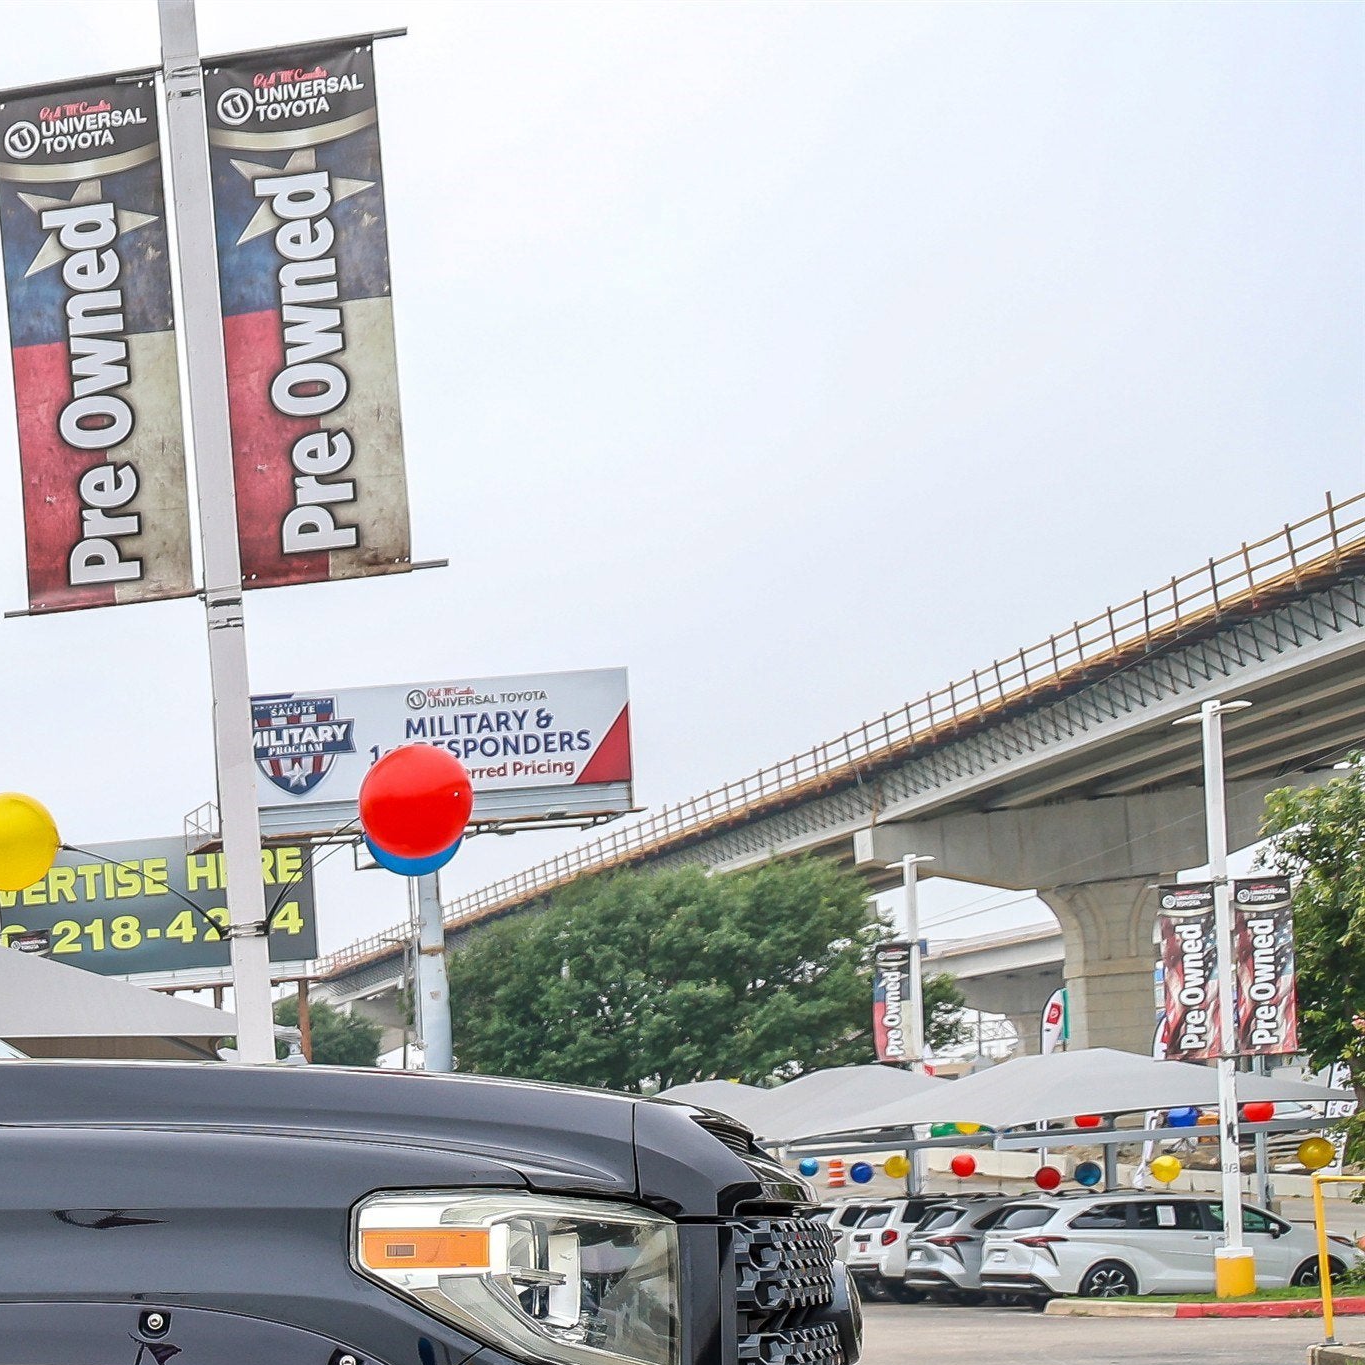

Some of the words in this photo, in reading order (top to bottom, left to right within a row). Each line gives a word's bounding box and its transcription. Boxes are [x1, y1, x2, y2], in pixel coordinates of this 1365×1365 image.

[254, 73, 364, 104] UNIVERSAL
[40, 107, 148, 138] UNIVERSAL
[255, 98, 330, 122] TOYOTA
[41, 129, 115, 154] TOYOTA
[254, 170, 348, 416] Owned
[41, 201, 134, 448] Owned
[282, 428, 358, 554] Pre
[70, 462, 143, 586] Pre
[271, 705, 316, 716] SALUTE
[428, 694, 498, 709] UNIVERSAL
[500, 690, 548, 702] TOYOTA
[405, 708, 530, 738] MILITARY
[536, 707, 554, 729] &
[268, 743, 323, 756] PROGRAM
[414, 729, 592, 758] SPONDERS
[513, 759, 575, 777] Pricing
[52, 902, 304, 953] 218-424
[1175, 923, 1205, 1006] Owned
[1247, 918, 1276, 1001] Owned
[1180, 1008, 1206, 1050] Pre
[1252, 1004, 1278, 1045] Pre
